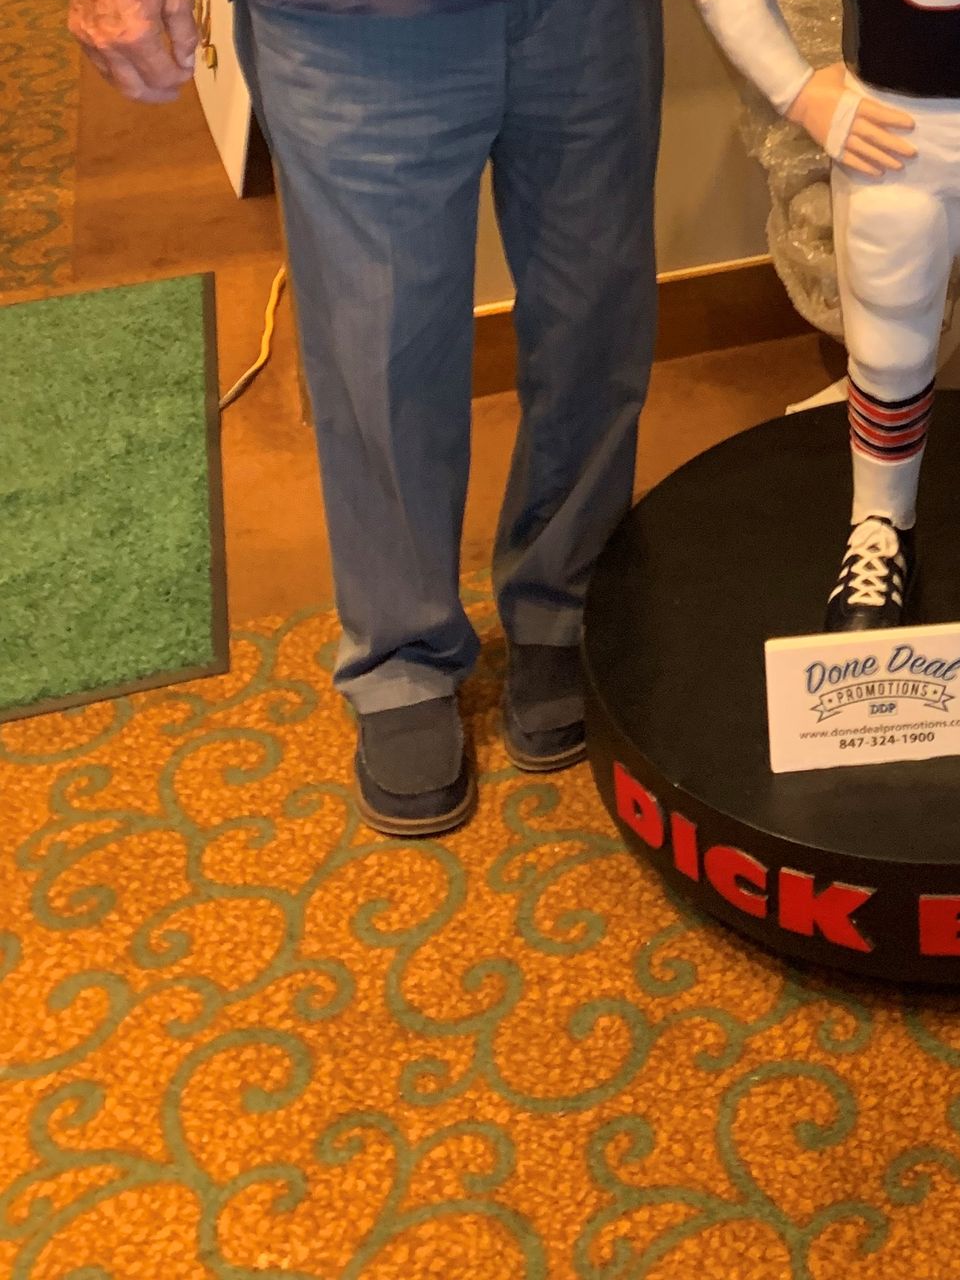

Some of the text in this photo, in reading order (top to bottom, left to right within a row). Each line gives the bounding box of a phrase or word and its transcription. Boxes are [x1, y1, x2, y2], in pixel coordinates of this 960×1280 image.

[805, 656, 879, 694] Done
[836, 680, 929, 705] PROMOTIONS
[869, 703, 897, 715] DDP
[838, 731, 936, 750] 847-324-1900
[613, 760, 878, 953] DICK
